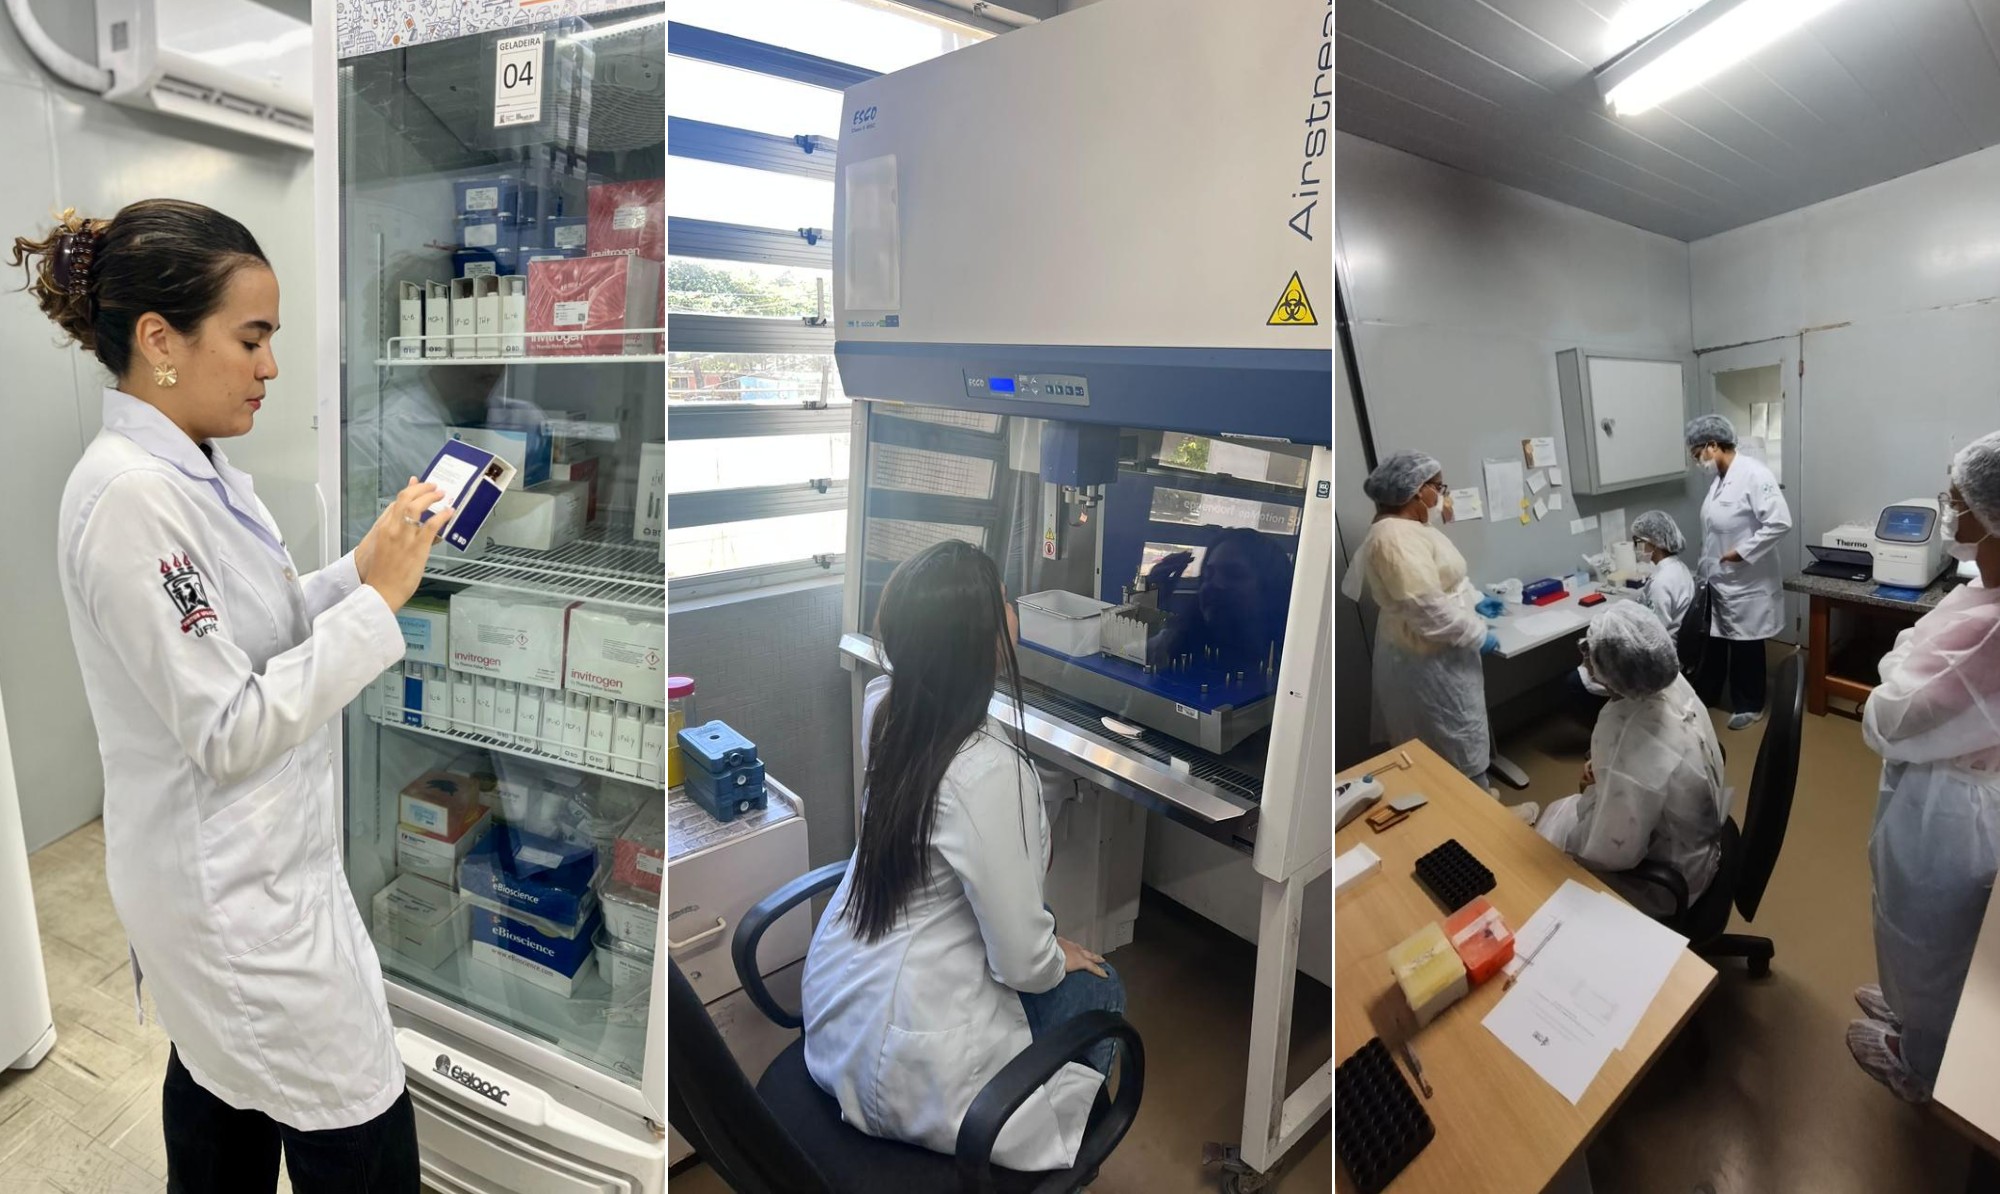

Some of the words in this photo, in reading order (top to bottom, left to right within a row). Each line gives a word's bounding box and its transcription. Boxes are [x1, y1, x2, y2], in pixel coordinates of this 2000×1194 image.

[499, 37, 541, 51] GELADEIRA
[503, 60, 533, 89] 04
[853, 106, 877, 125] ESCO
[1288, 0, 1332, 241] Airstrea
[457, 536, 467, 546] BD
[1835, 538, 1868, 548] Thermo
[194, 623, 218, 638] UFPE
[454, 650, 502, 667] invitrogen
[570, 668, 623, 688] invitrogen
[492, 882, 540, 904] eBioscience
[491, 926, 556, 957] eBioscience
